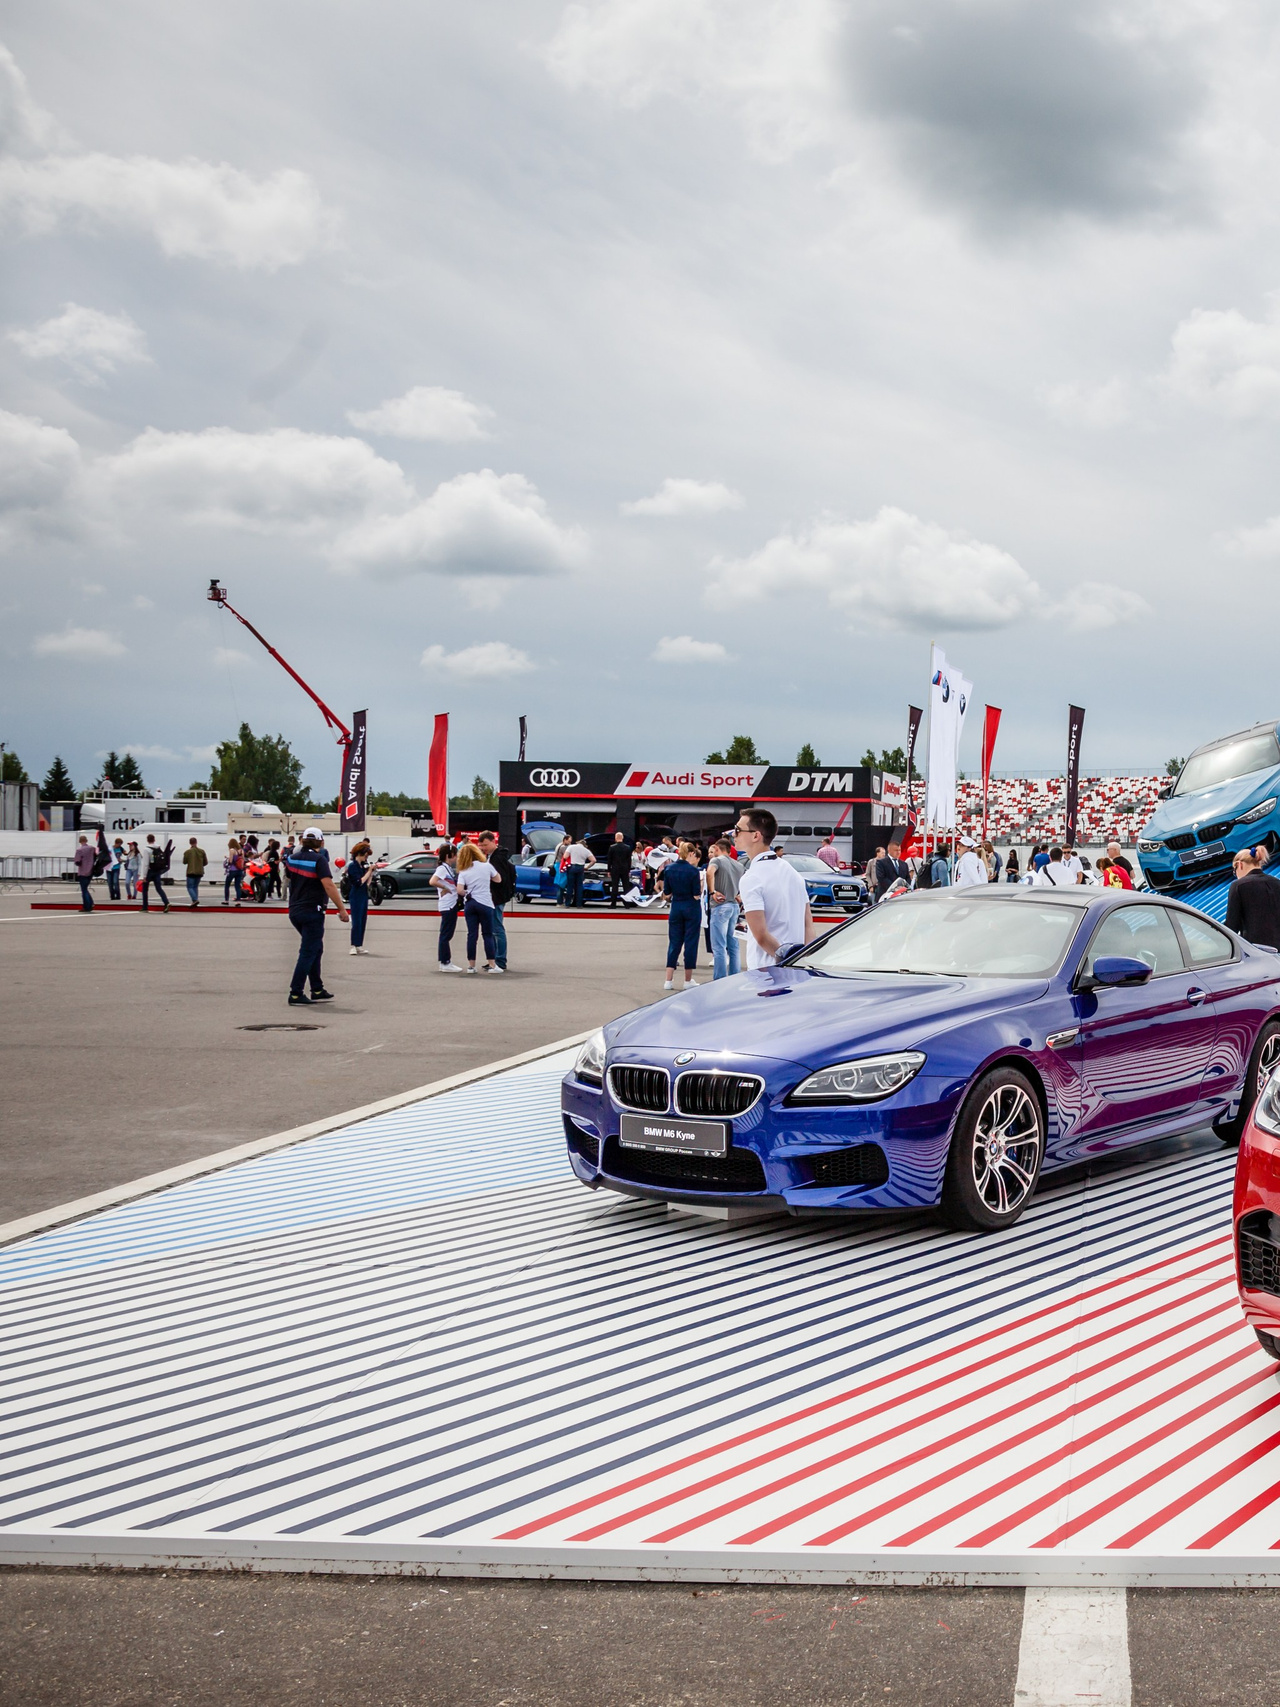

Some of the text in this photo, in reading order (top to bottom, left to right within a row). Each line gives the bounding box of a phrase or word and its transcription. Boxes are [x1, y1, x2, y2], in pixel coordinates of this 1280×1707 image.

[650, 772, 755, 789] Audi Sport
[787, 772, 854, 793] DTM
[643, 1126, 663, 1137] BMW
[663, 1128, 676, 1139] M6
